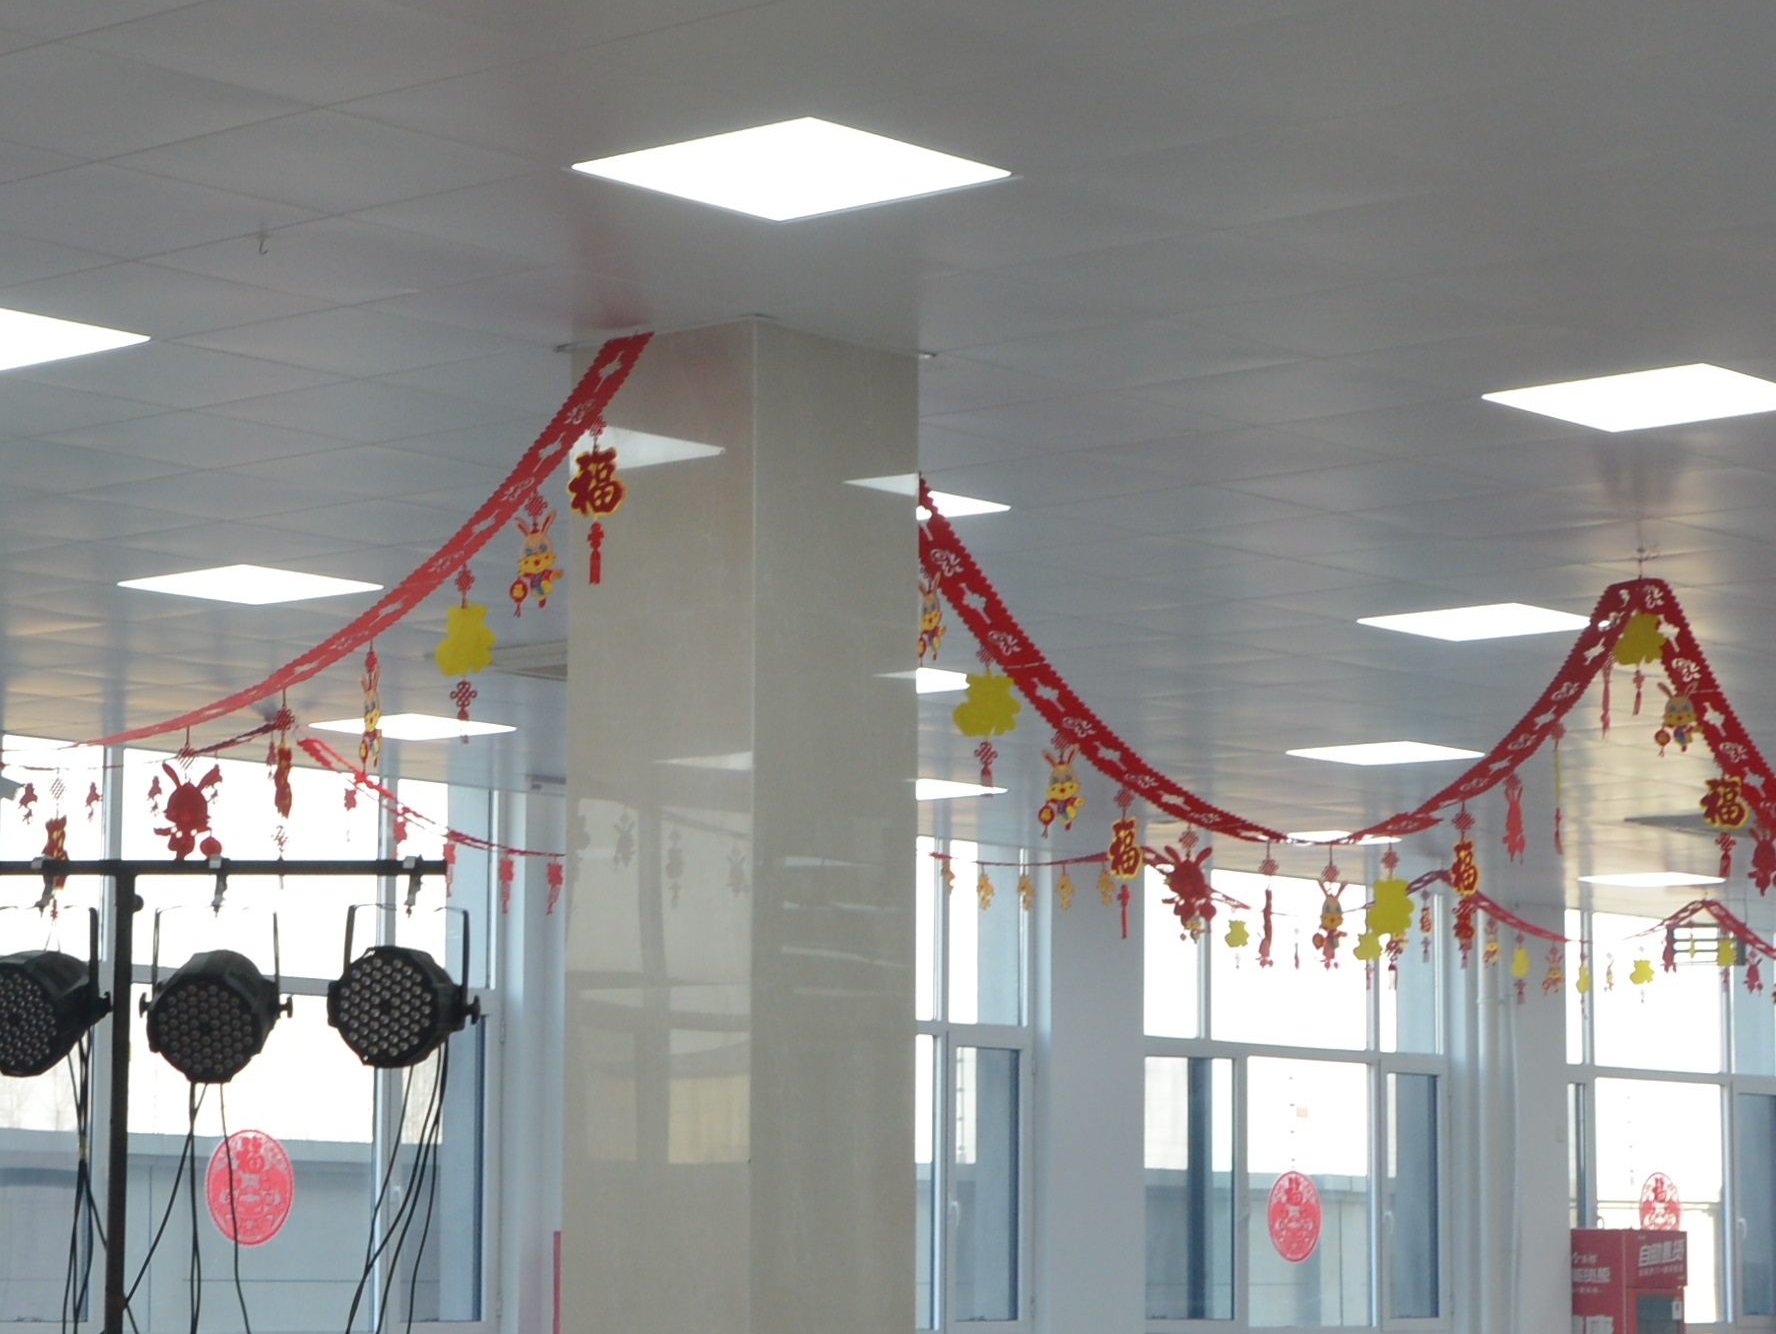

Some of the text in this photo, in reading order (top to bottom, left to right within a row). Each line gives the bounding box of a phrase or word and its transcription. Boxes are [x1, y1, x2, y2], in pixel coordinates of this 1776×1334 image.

[569, 450, 625, 515] 福
[1701, 776, 1748, 827] 福
[1109, 818, 1143, 878] 福
[1452, 841, 1479, 896] 福
